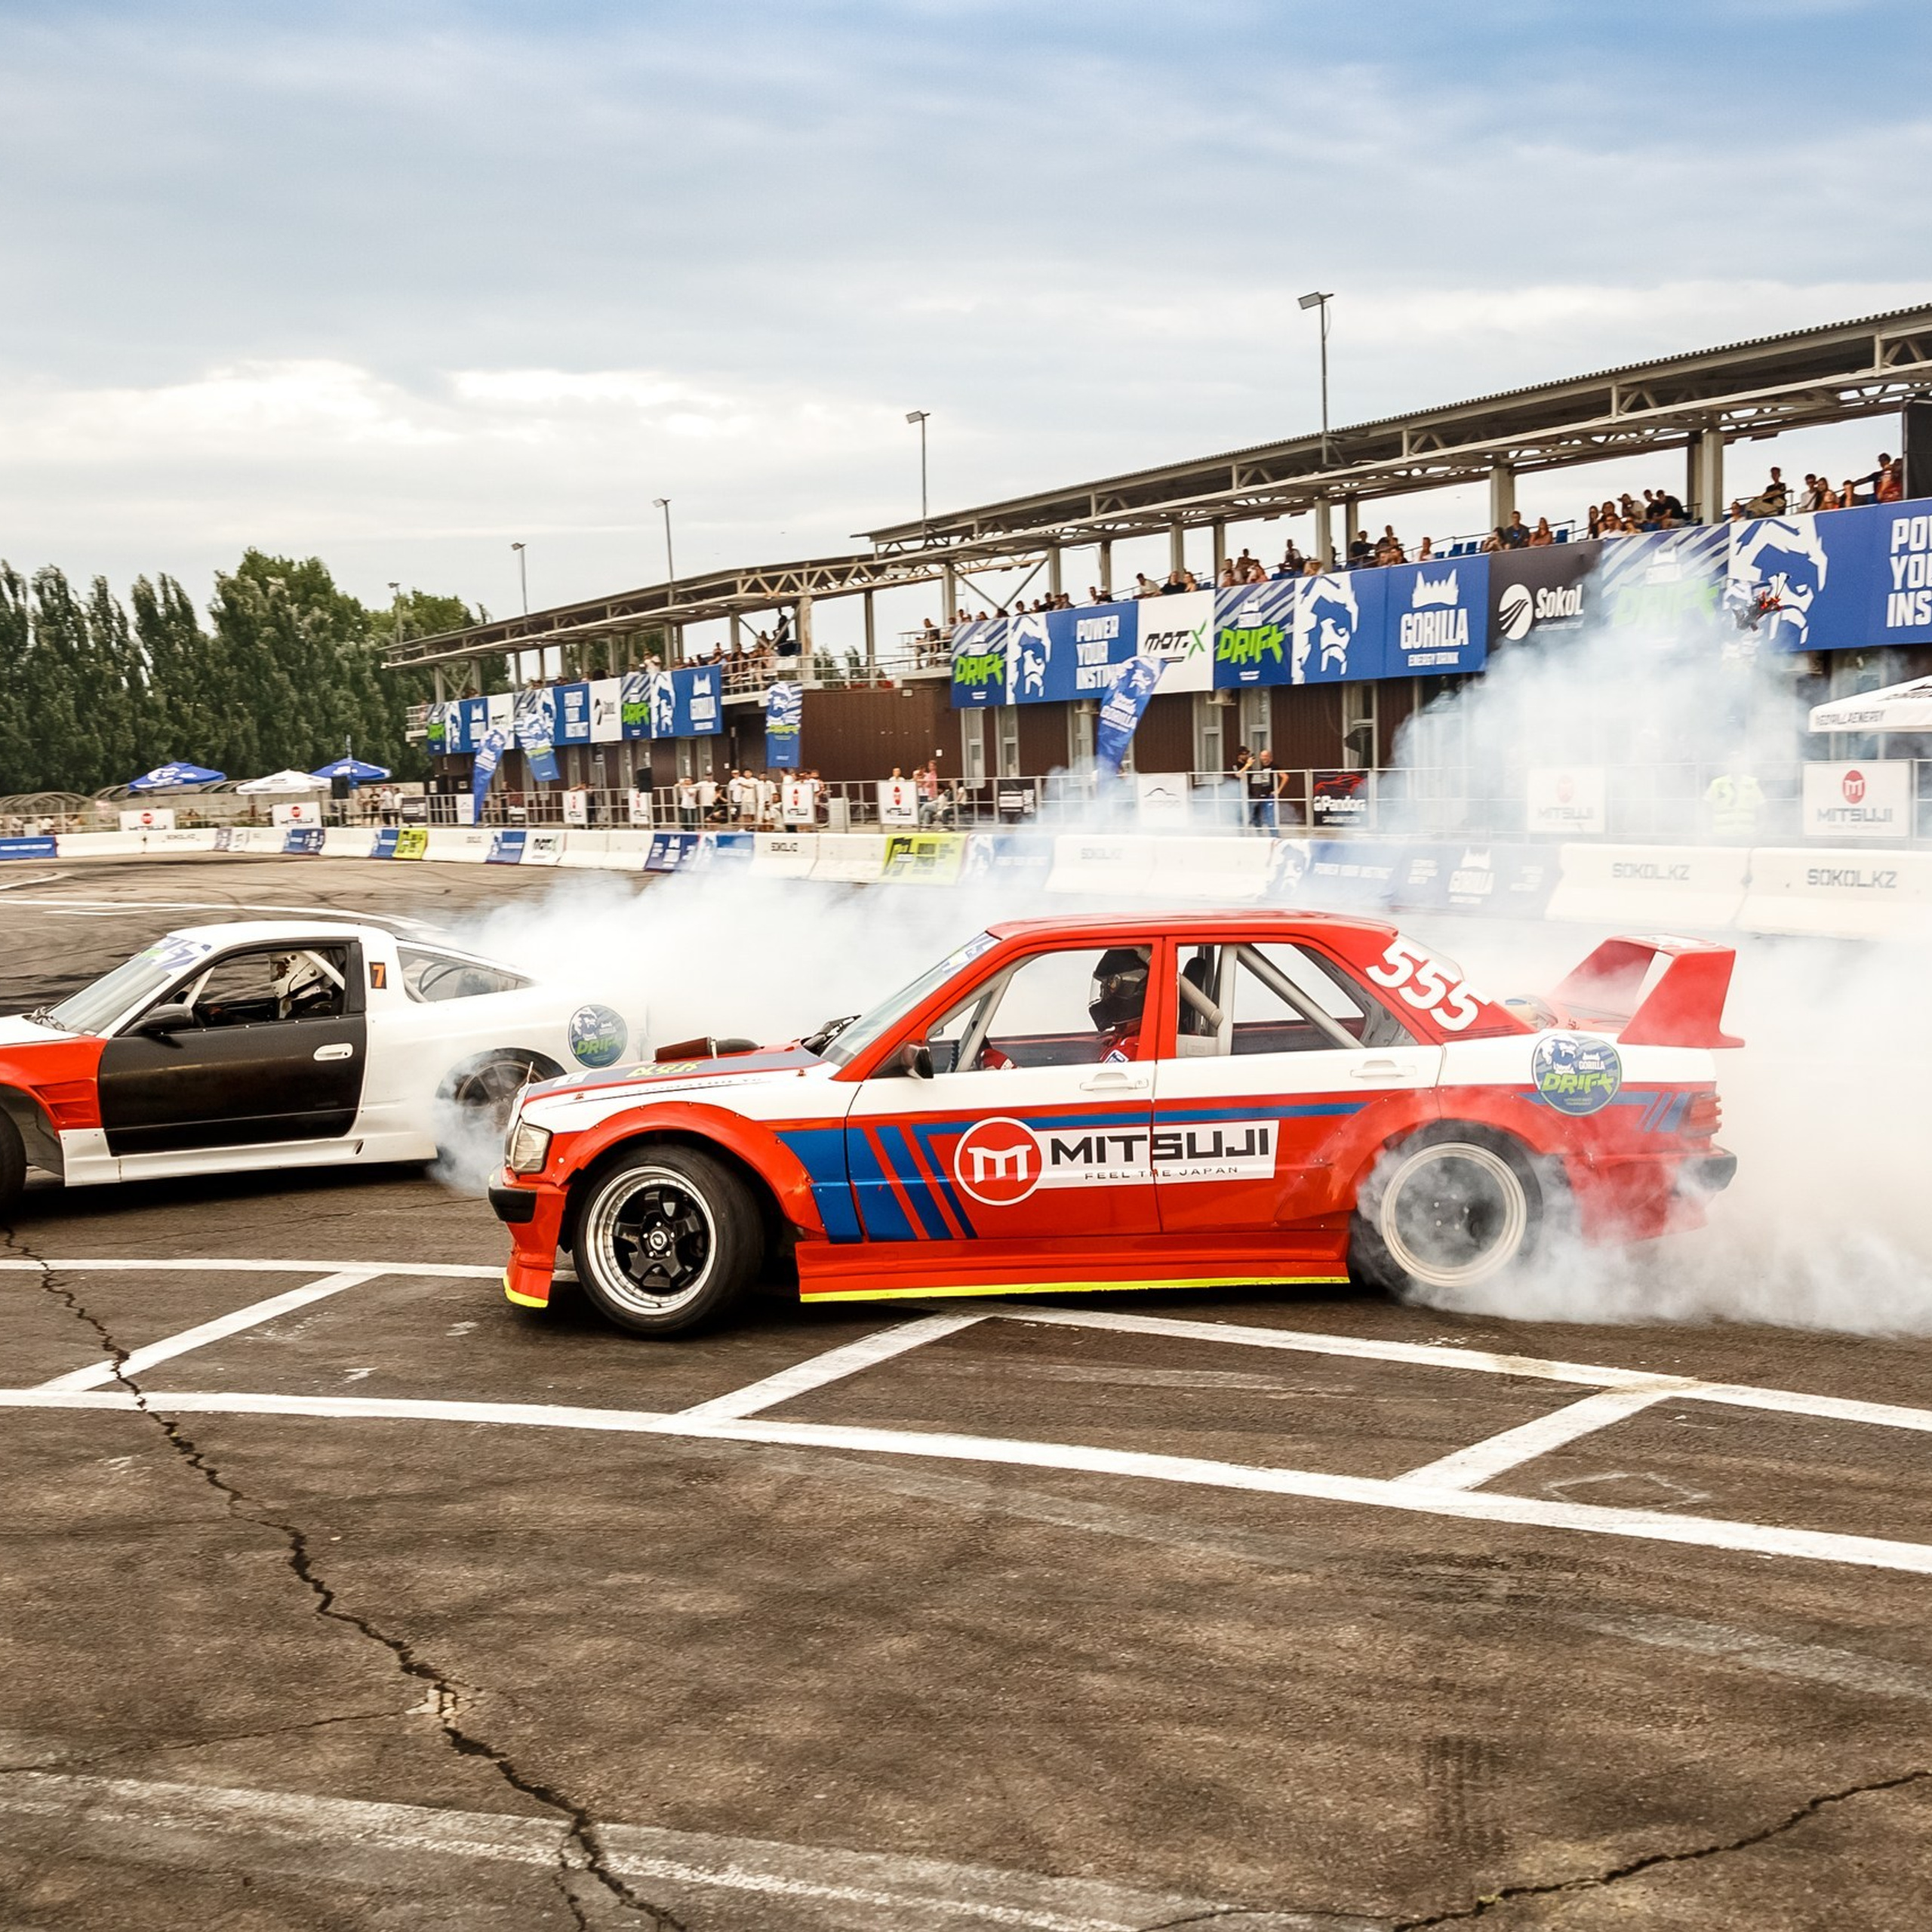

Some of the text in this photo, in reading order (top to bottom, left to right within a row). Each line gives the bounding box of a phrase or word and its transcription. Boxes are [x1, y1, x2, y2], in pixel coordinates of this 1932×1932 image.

[1076, 615, 1119, 642] POWER
[1400, 608, 1469, 650] GORILLA
[1216, 624, 1284, 665] DRIFT
[954, 653, 1004, 686] DRIFT
[1817, 808, 1893, 823] MITSUJI
[373, 964, 384, 987] 7
[1365, 940, 1493, 1032] 555
[1541, 1072, 1614, 1095] DRIFT
[1051, 1128, 1269, 1165] MITSUJI
[1138, 1170, 1171, 1178] THE
[1180, 1167, 1238, 1176] JAPAN
